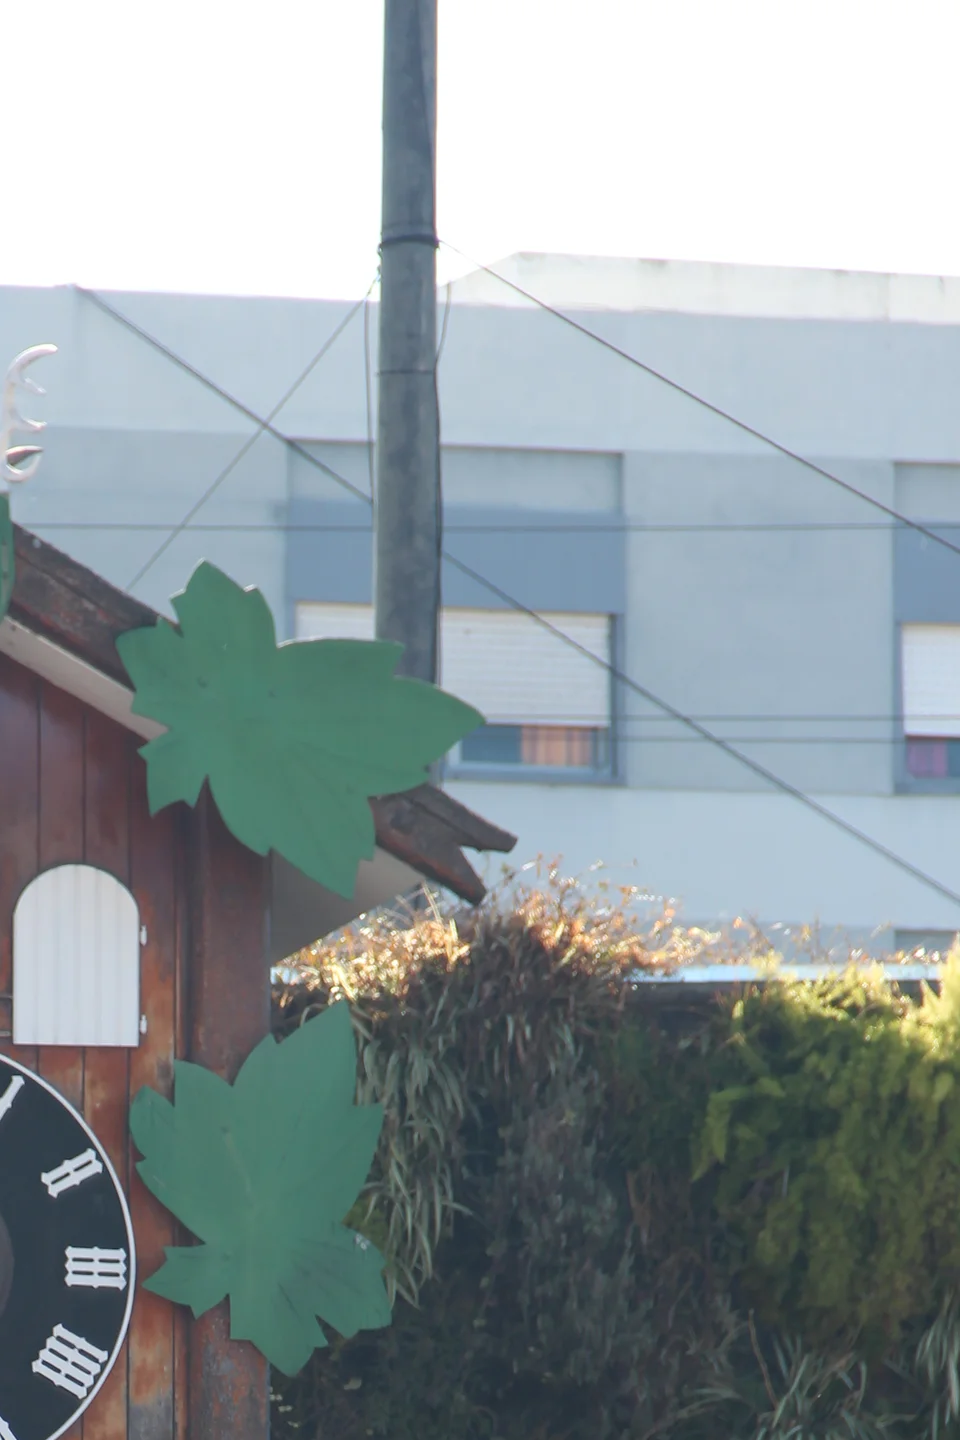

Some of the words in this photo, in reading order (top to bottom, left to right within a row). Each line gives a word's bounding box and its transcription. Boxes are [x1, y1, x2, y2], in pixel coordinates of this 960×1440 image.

[41, 1148, 103, 1198] II
[64, 1246, 128, 1291] III
[31, 1323, 108, 1400] IIII
